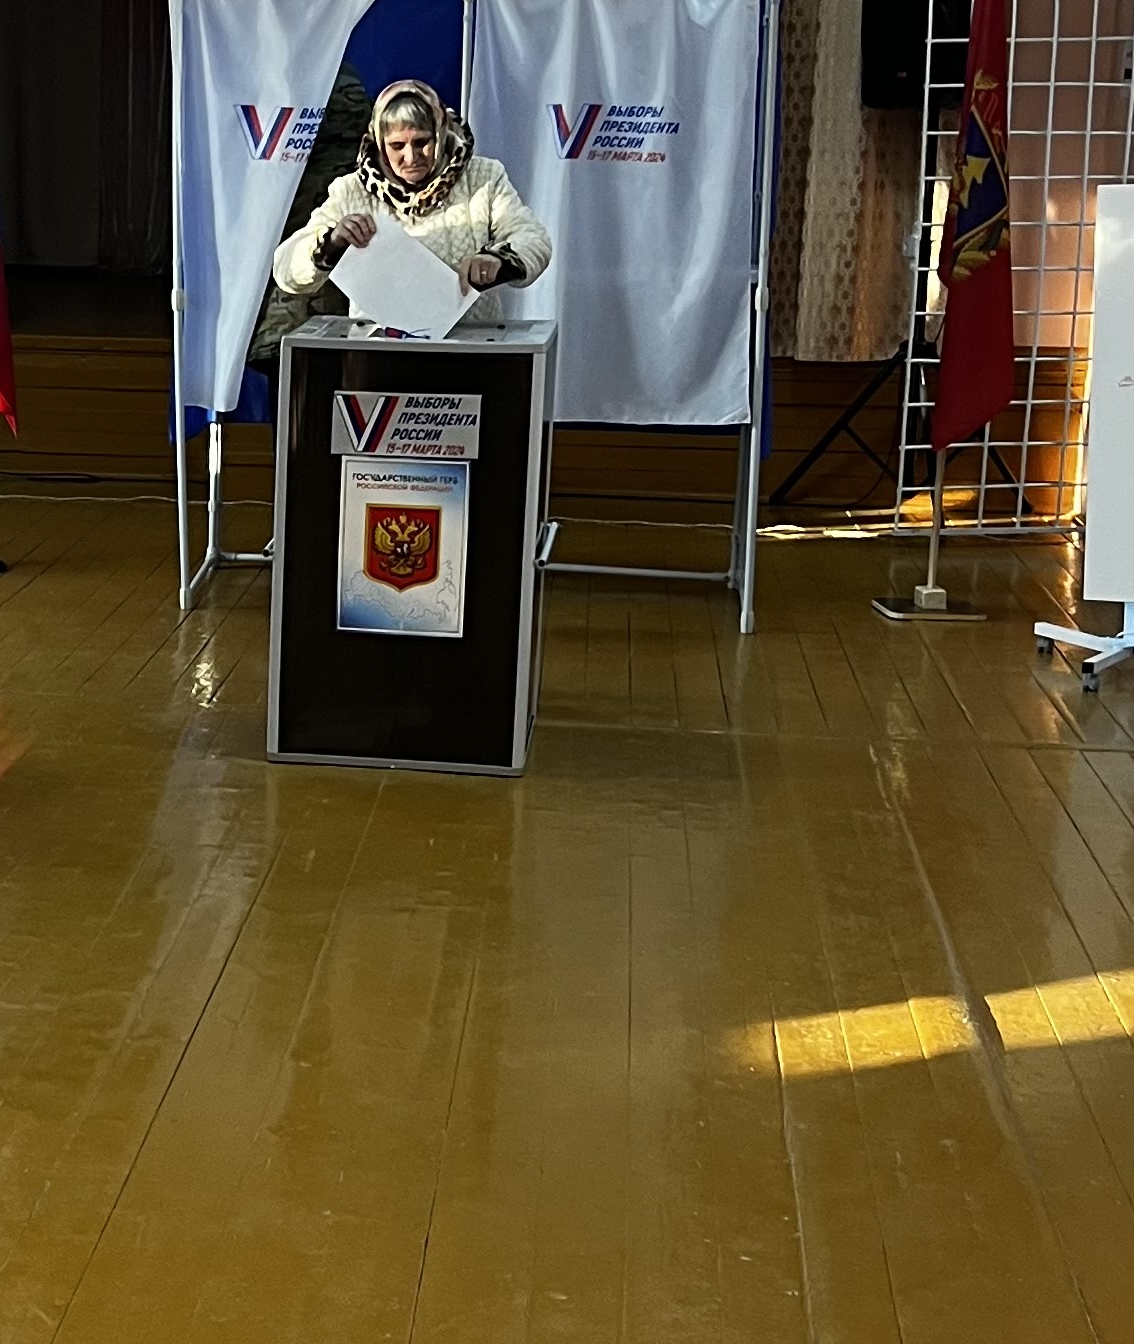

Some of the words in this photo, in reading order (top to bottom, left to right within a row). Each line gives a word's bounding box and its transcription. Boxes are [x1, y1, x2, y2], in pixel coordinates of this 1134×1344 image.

[607, 105, 664, 117] ВЫБОРЫ
[292, 123, 319, 134] ПРЕ
[599, 121, 680, 135] ПРЕЗИДЕНТА
[592, 136, 644, 148] РОССИИ
[612, 151, 643, 162] МАРТА
[643, 152, 666, 162] 2024
[405, 396, 462, 410] ВЫБОРЫ
[397, 412, 477, 427] ПРЕЗИДЕНТА
[390, 428, 443, 441] РОССИИ
[411, 444, 441, 455] МАРТА
[442, 446, 465, 456] 2024
[352, 472, 437, 483] ГОСУДАРСТВЕННЫЙ
